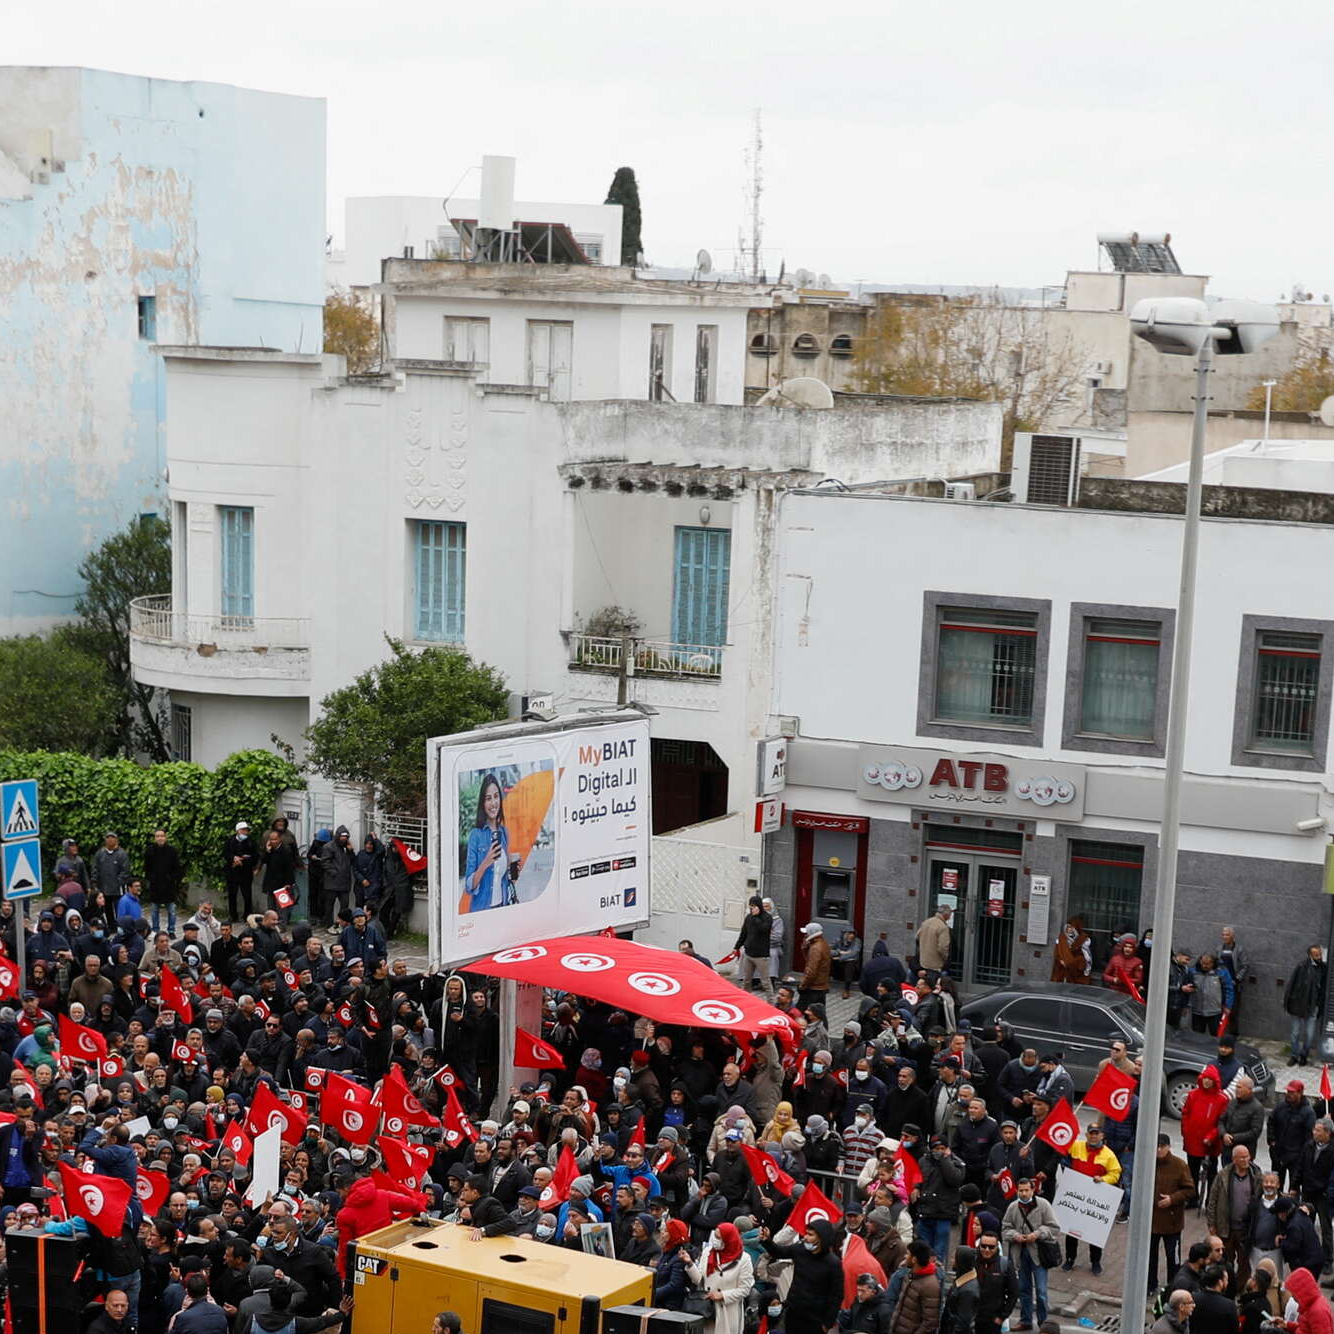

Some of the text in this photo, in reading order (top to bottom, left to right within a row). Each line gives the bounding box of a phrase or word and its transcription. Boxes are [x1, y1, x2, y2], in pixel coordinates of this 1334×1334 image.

[578, 740, 637, 767] MyBIAT
[578, 768, 623, 796] Digital
[929, 758, 1009, 792] ATB
[599, 894, 621, 909] BIAT
[357, 1255, 380, 1274] CAT
